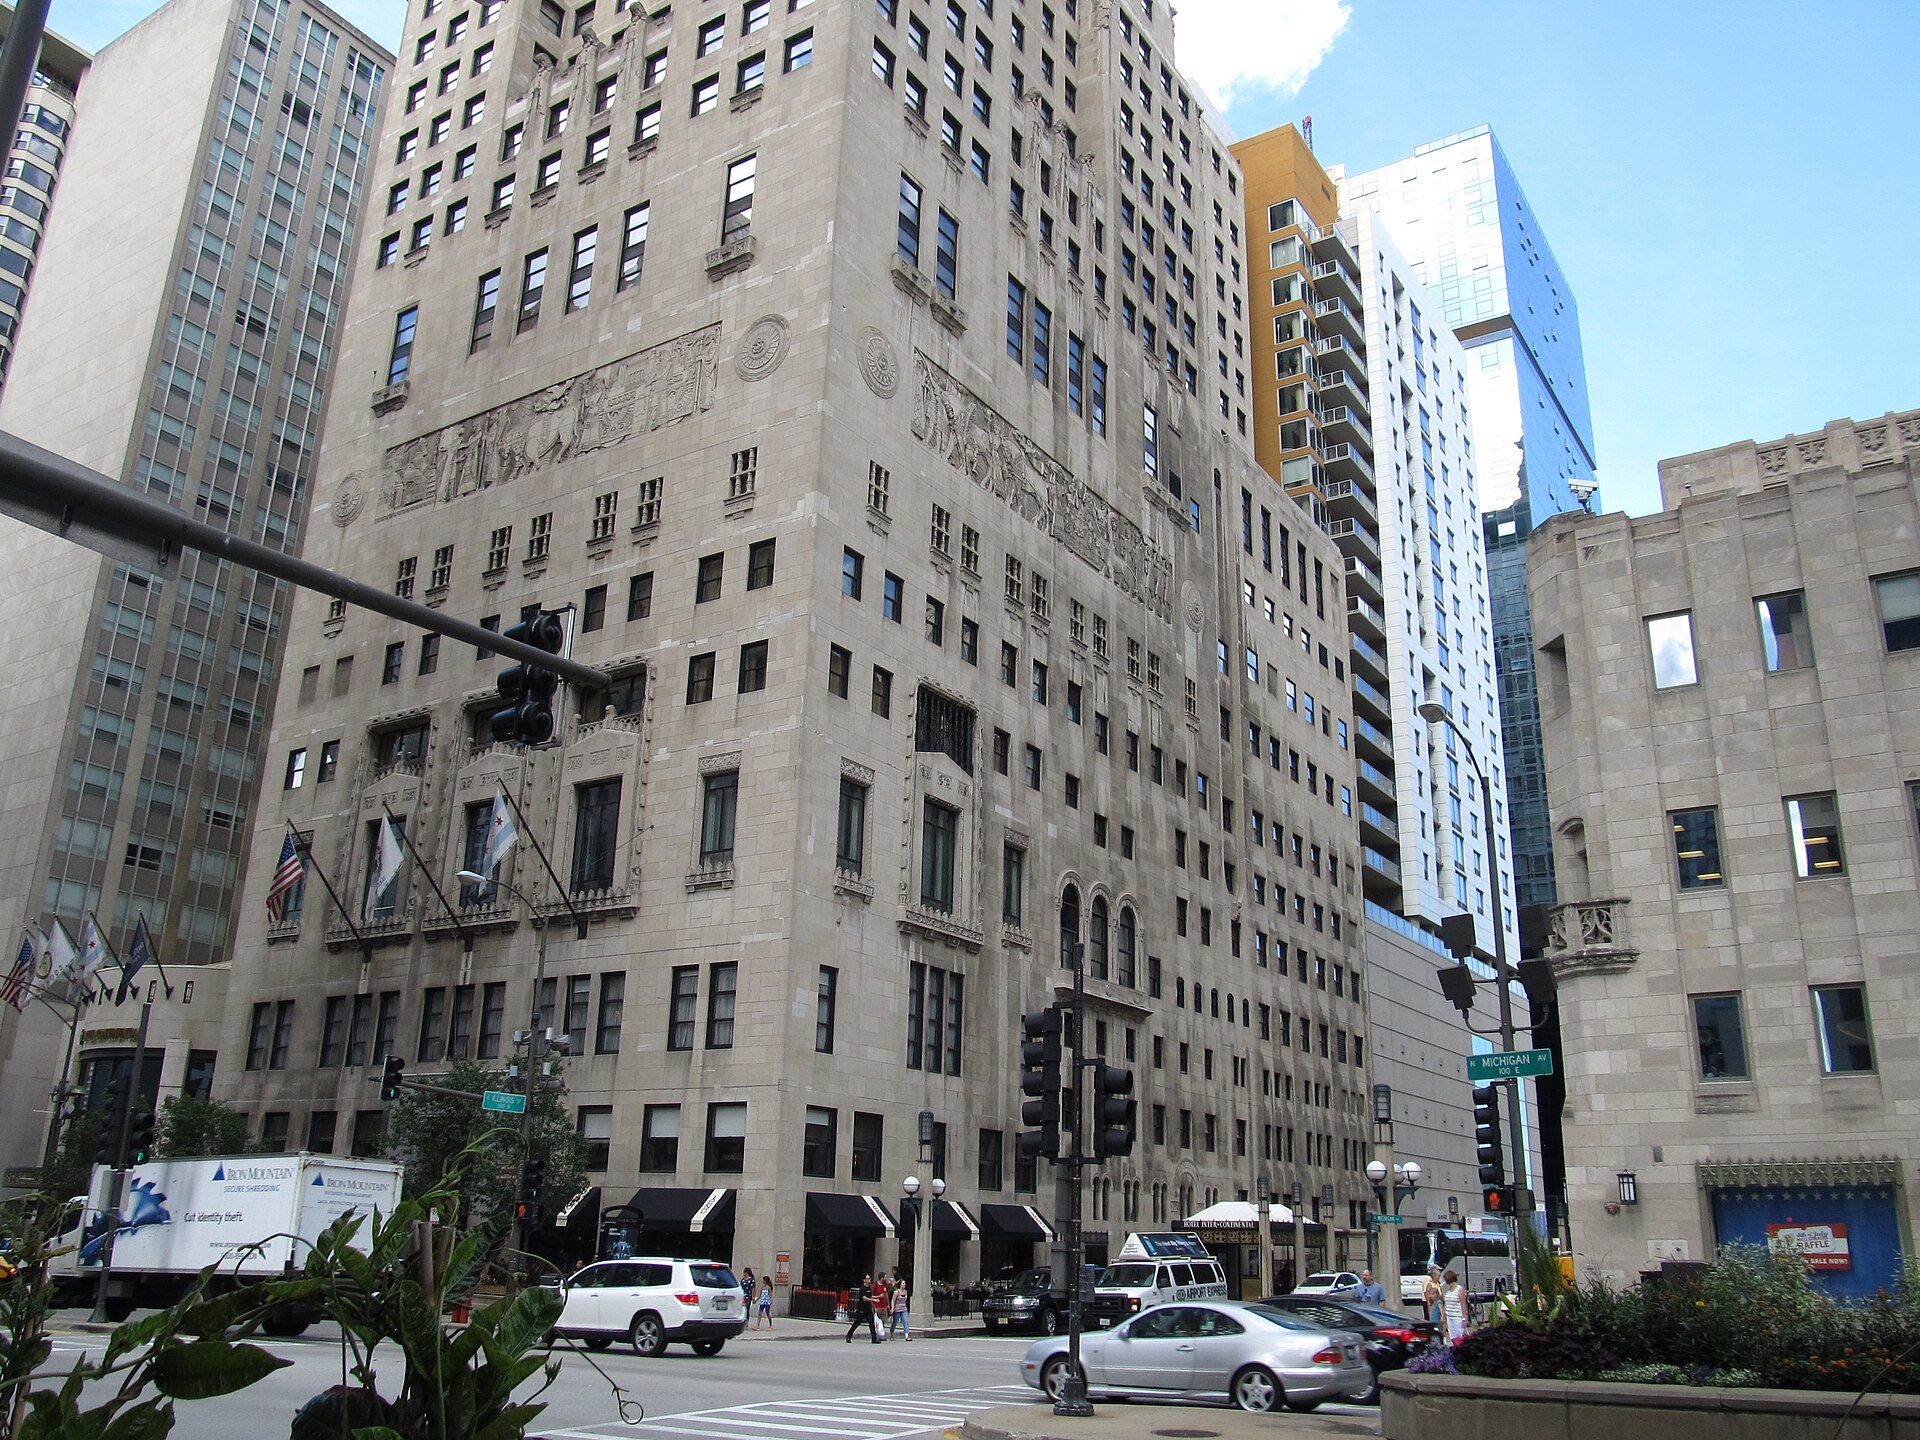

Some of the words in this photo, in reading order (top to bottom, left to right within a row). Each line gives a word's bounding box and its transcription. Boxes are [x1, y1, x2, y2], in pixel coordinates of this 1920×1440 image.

[1482, 1054, 1530, 1067] MICHIGAN
[1537, 1054, 1547, 1062] AV
[1498, 1067, 1511, 1075] 100
[227, 1167, 246, 1180] IRON
[246, 1167, 293, 1180] MOUNTAIN
[224, 1185, 244, 1193] SECURE
[245, 1184, 280, 1193] SHREDDING
[327, 1178, 346, 1188] IRON
[346, 1180, 388, 1191] MOUNTAIN
[184, 1212, 196, 1222] Cut
[197, 1211, 224, 1225] identity
[1797, 1240, 1830, 1249] RAFFLE
[1187, 1287, 1206, 1299] AIRPORT
[1208, 1285, 1227, 1297] EXPRESS
